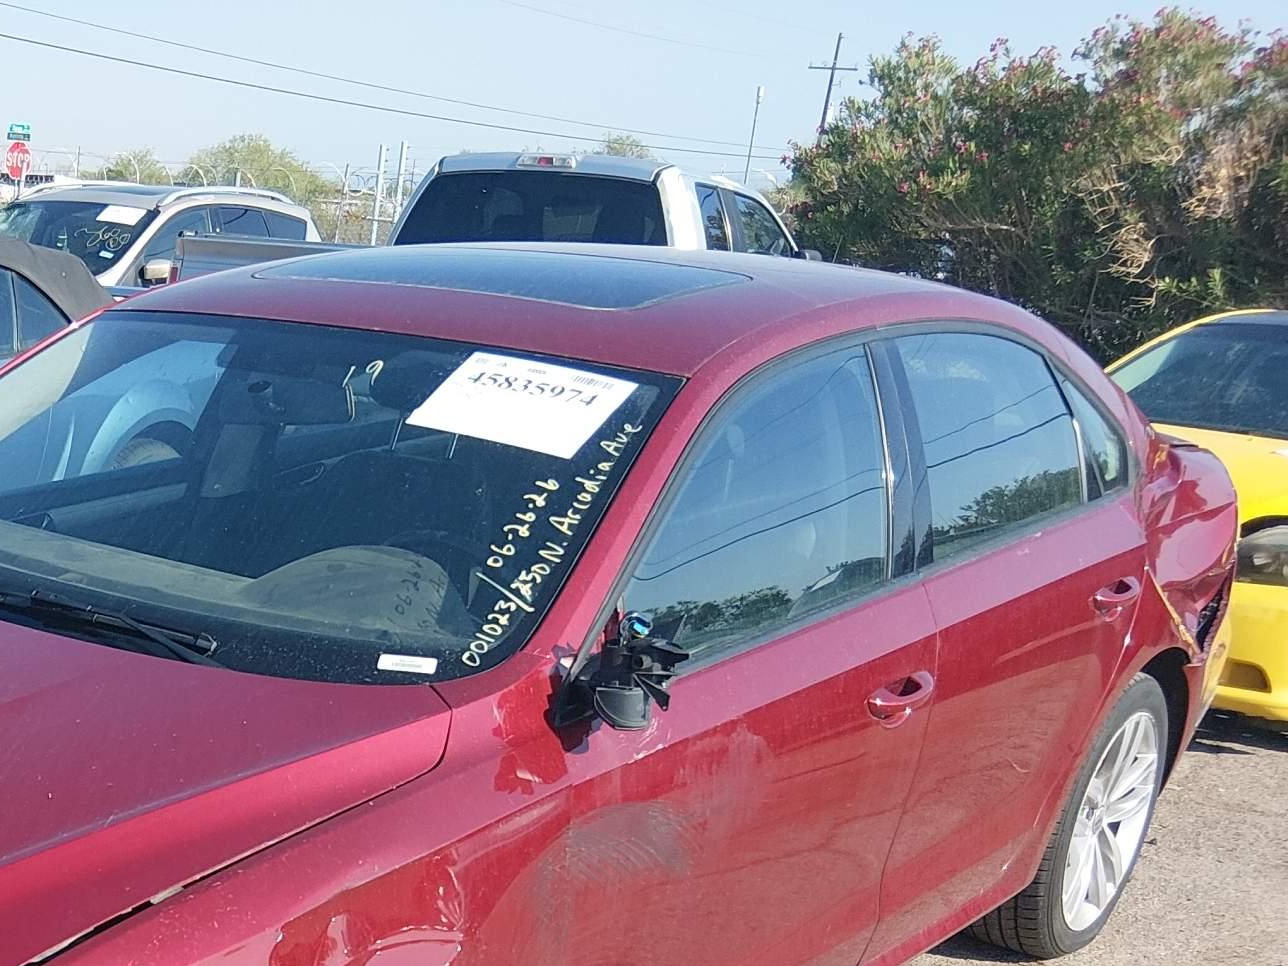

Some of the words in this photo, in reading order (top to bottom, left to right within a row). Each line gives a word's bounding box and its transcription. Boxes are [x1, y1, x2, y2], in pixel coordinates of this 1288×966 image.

[6, 152, 30, 168] STOP
[467, 371, 599, 407] 45835974
[599, 422, 643, 457] Ave
